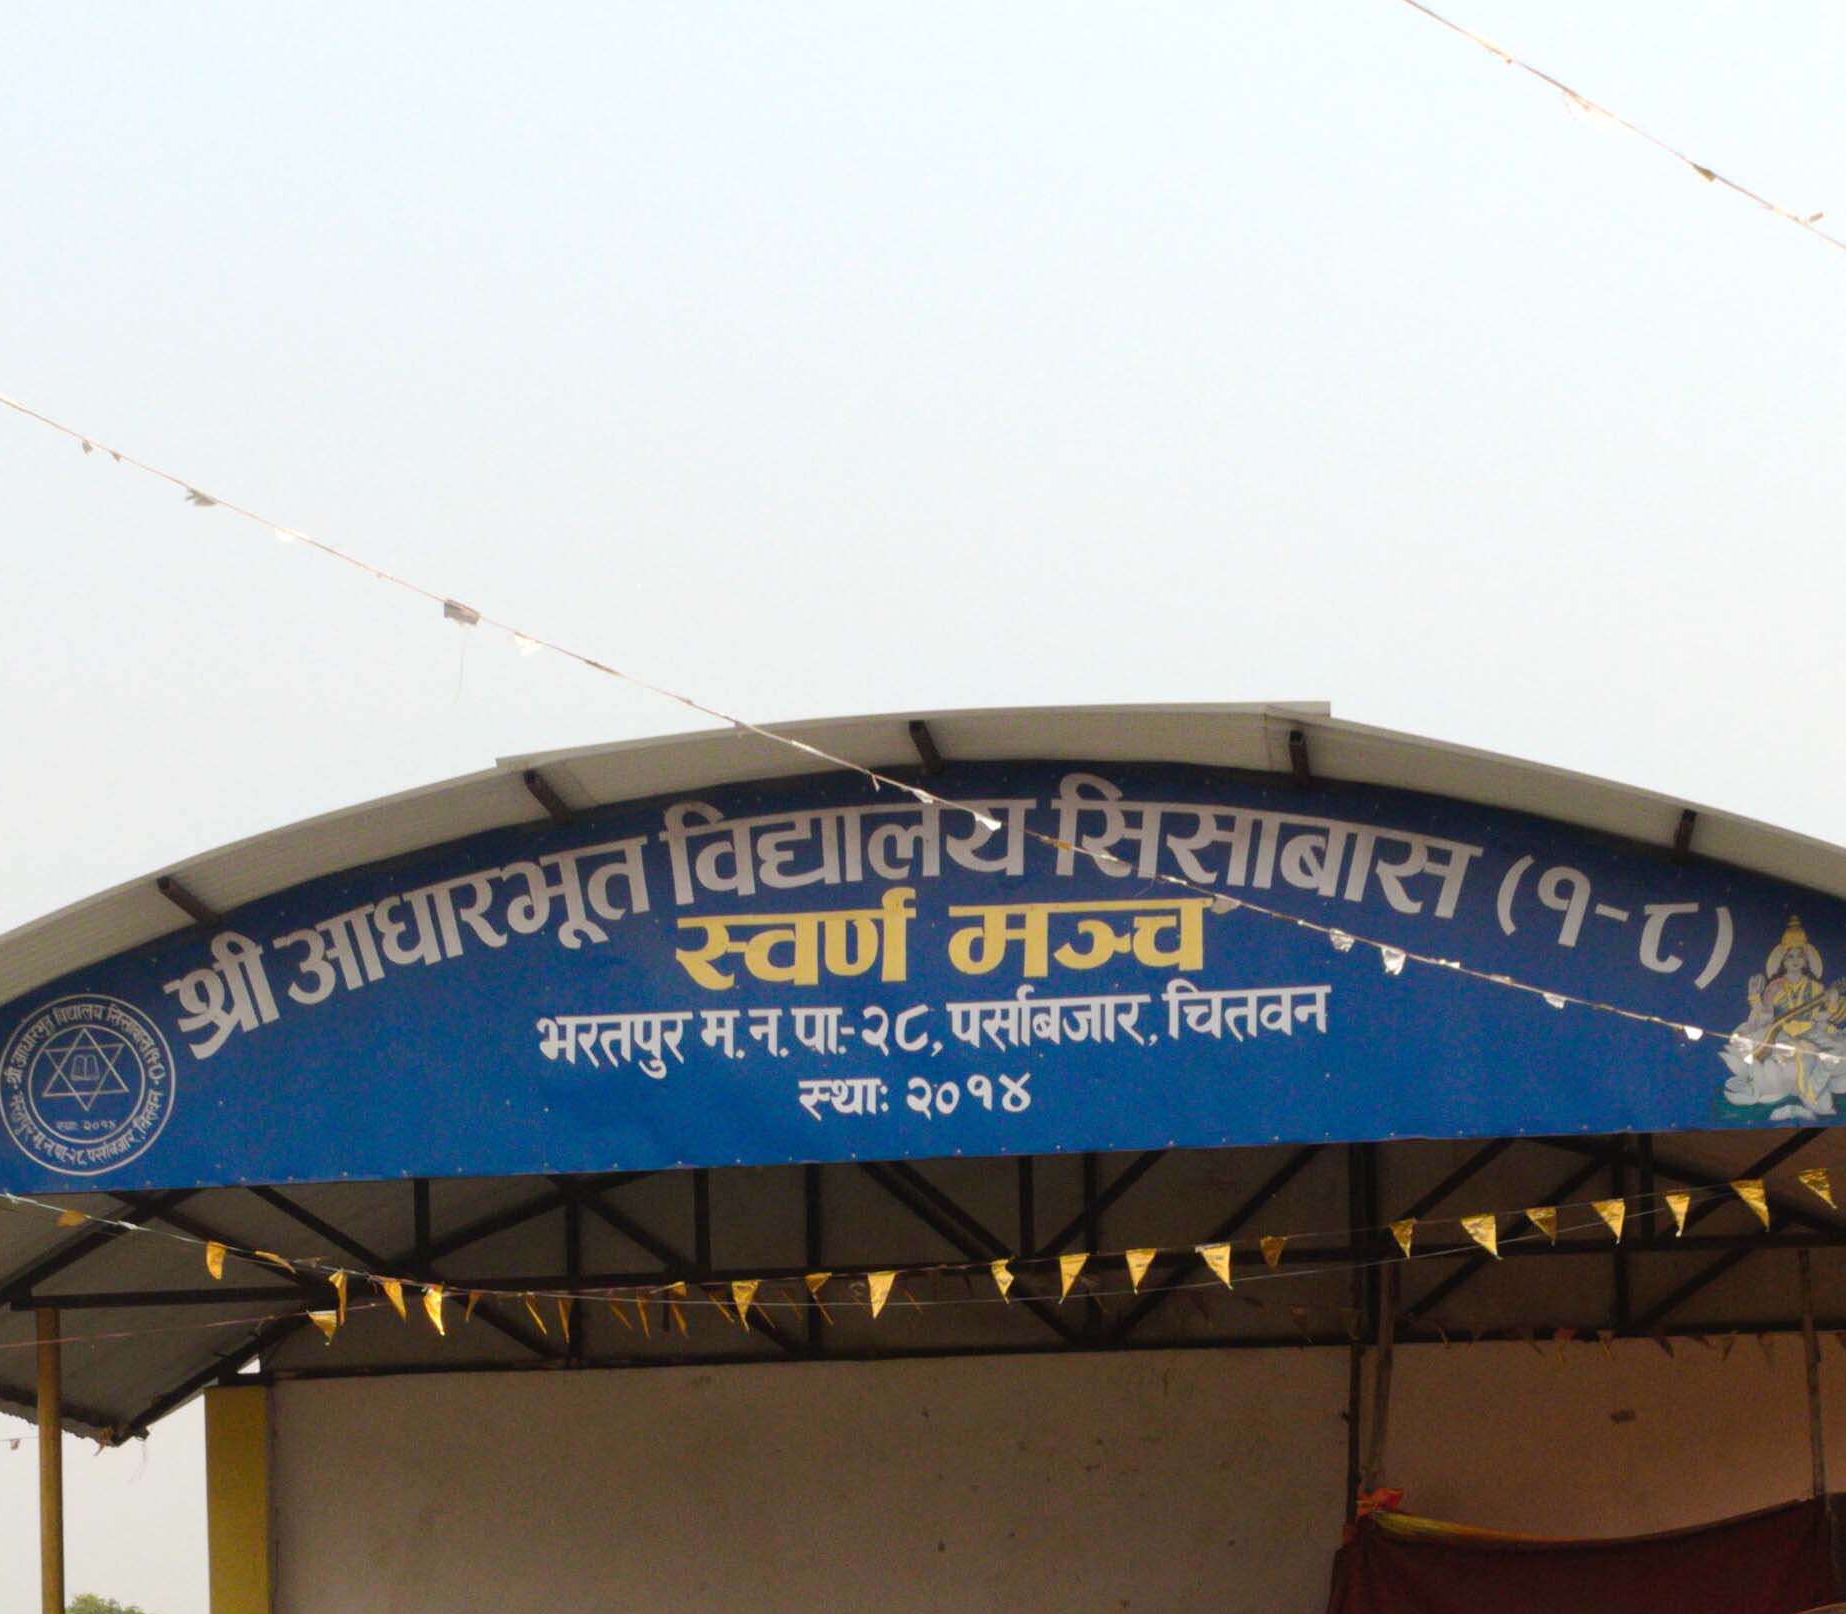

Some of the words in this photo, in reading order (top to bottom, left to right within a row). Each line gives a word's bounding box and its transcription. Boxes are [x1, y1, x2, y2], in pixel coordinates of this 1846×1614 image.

[163, 931, 281, 1059] श्री
[272, 835, 651, 1005] आधारभूत
[660, 800, 1037, 906] विद्यालय
[1050, 772, 1484, 920] सिसाबास
[674, 886, 917, 992] स्वर्ण
[948, 896, 1217, 980] मञ्च
[536, 1010, 694, 1079] भरतपुर
[1161, 978, 1333, 1043] चितवन
[906, 1072, 1033, 1120] २०१४
